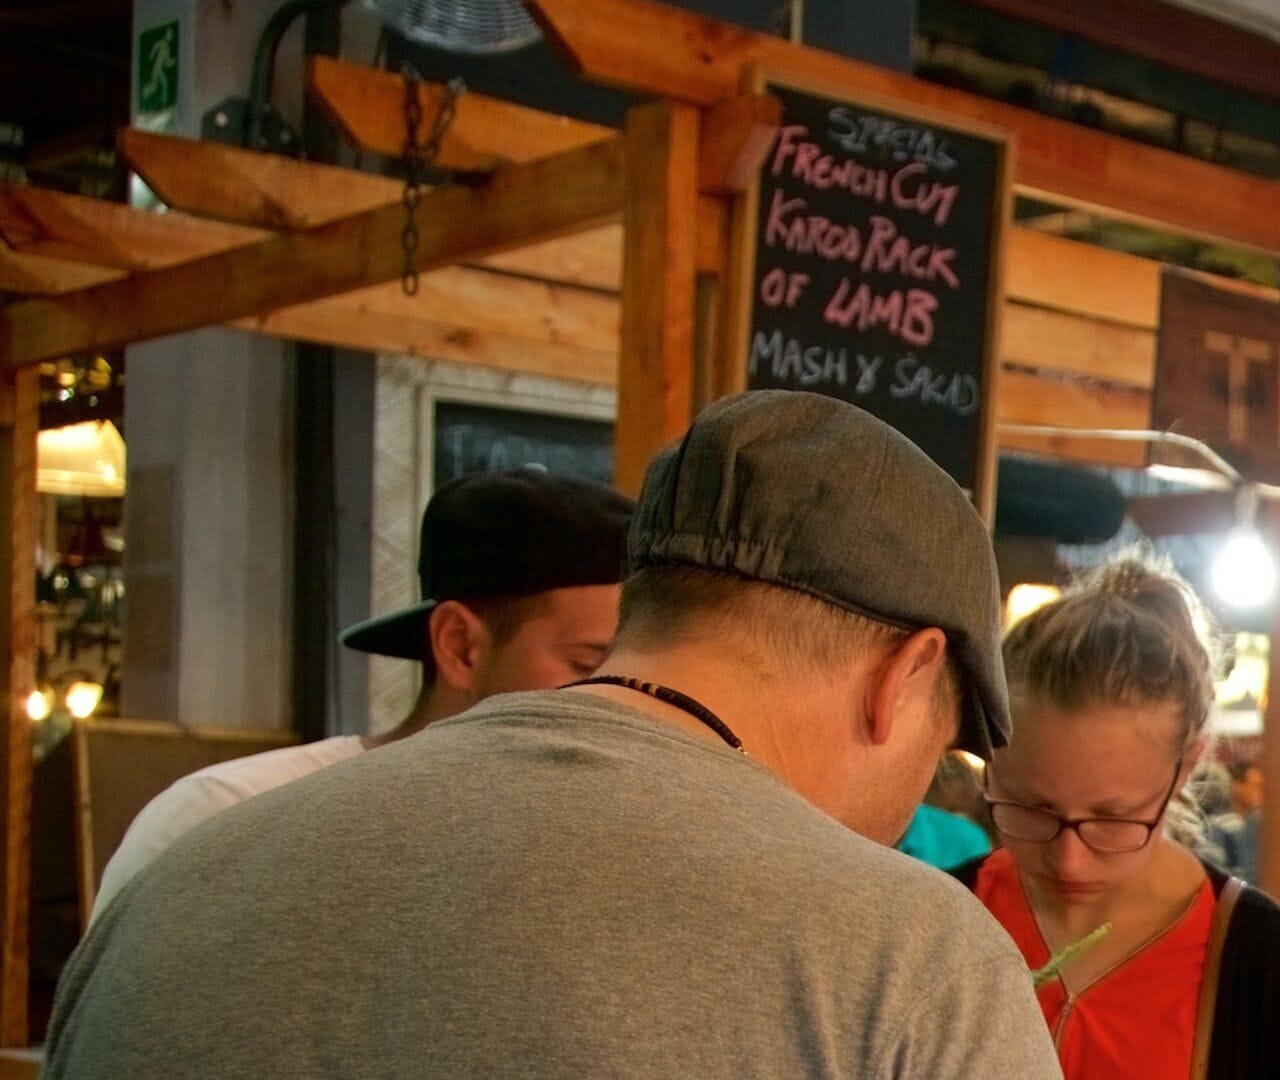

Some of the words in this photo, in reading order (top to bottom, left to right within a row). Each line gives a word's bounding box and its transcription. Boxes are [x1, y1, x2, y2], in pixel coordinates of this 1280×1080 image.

[772, 125, 888, 202] FRENCH
[862, 216, 959, 288] RACK
[761, 269, 810, 308] OF
[823, 277, 938, 346] LAMB
[749, 329, 847, 386] MASH
